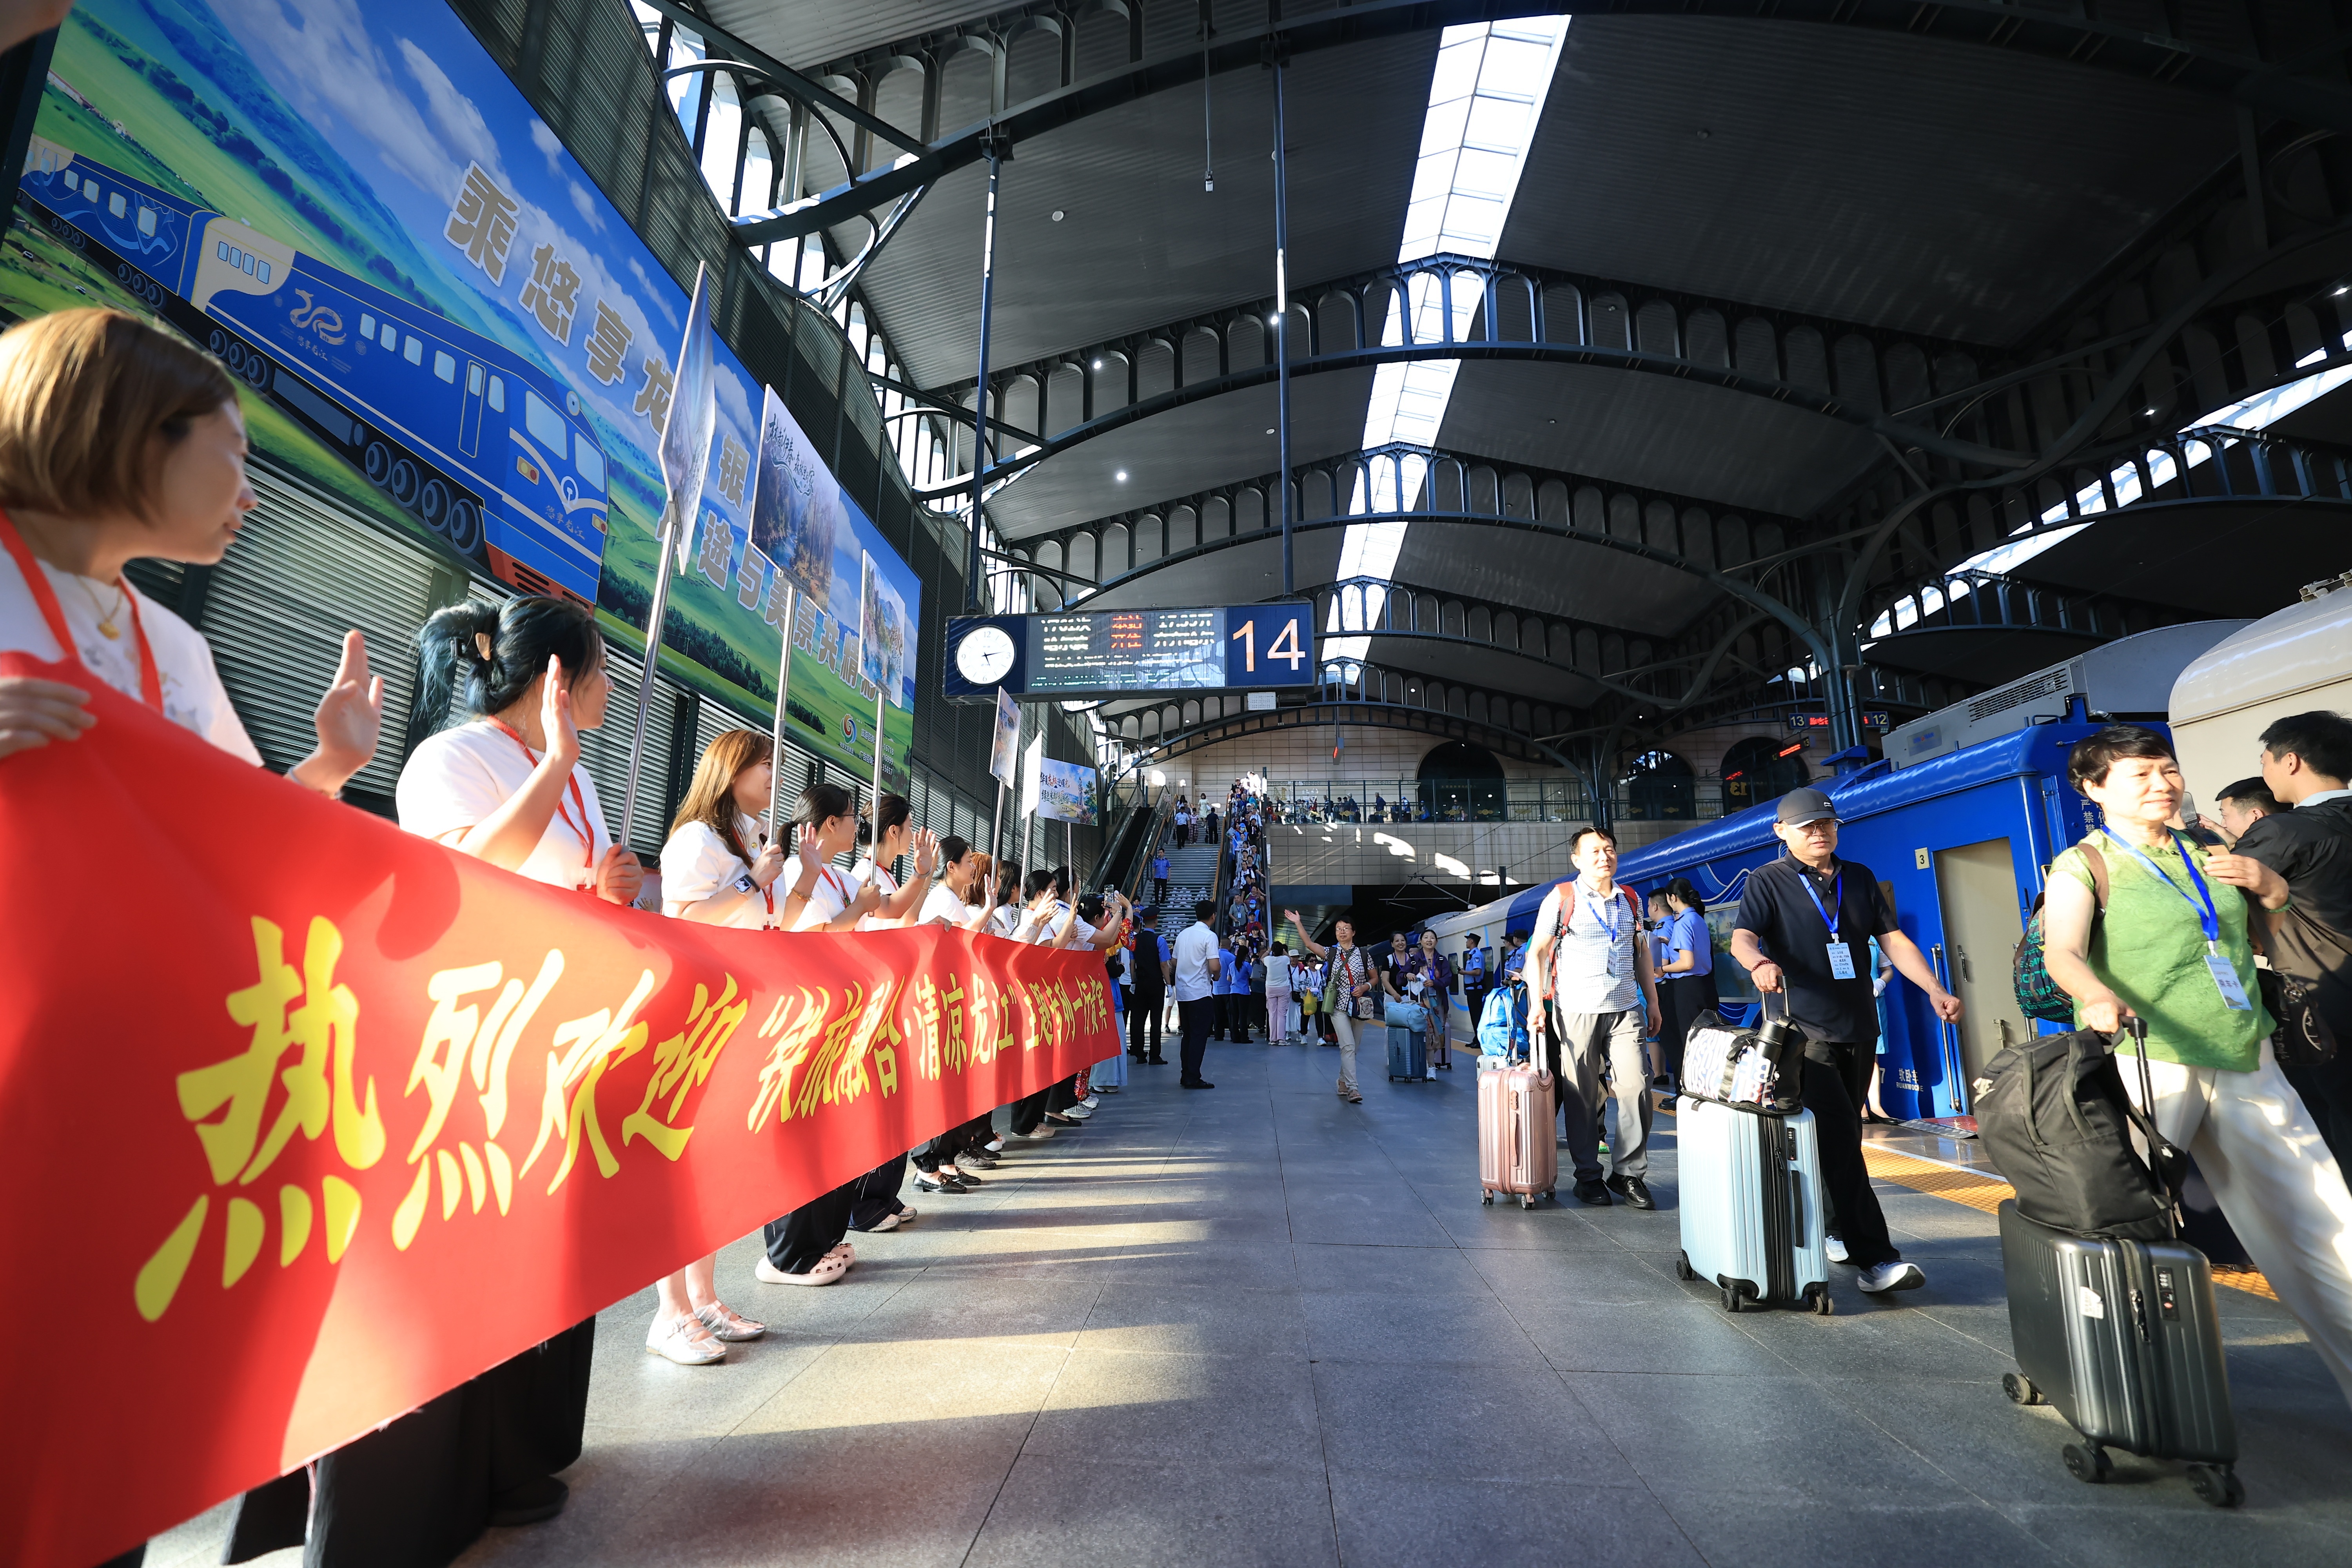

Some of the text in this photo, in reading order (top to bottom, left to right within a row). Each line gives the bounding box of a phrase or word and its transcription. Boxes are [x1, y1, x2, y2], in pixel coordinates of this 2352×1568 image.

[655, 505, 877, 702] 途与美景共精
[1233, 619, 1305, 672] 14
[1791, 716, 1805, 726] 13
[1873, 714, 1887, 725] 12
[1920, 855, 1925, 864] 3
[1898, 1068, 1919, 1084] 软卧车
